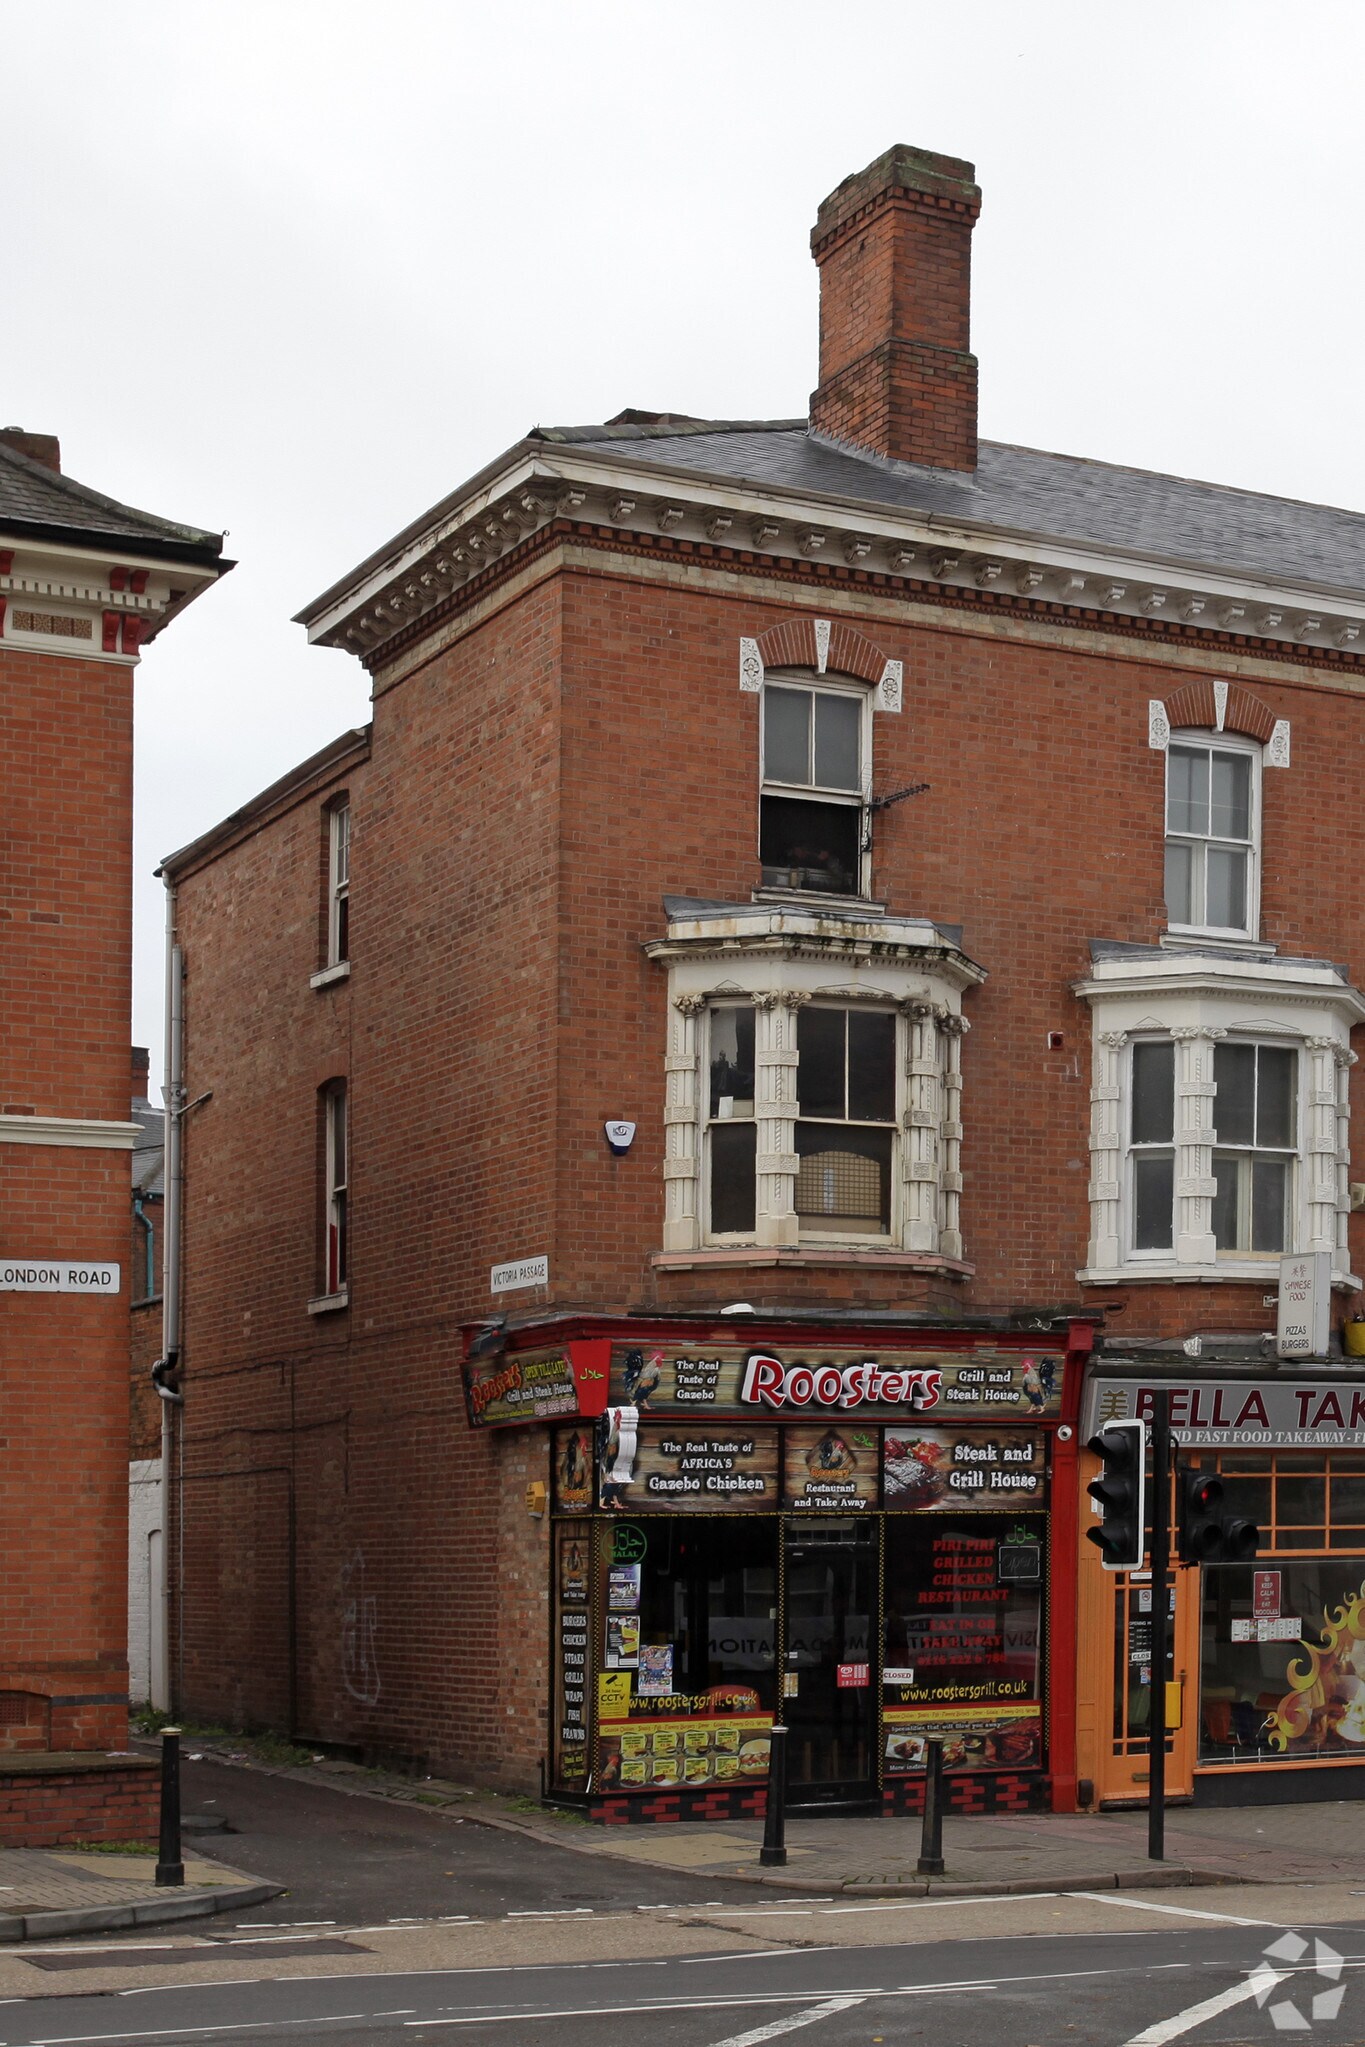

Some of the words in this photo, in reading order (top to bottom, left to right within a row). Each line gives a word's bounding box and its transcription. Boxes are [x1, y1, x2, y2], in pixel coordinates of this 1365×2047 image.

[68, 1270, 112, 1285] ROAD
[493, 1269, 518, 1285] VICTORIA
[520, 1263, 545, 1280] PASSAGE
[1284, 1280, 1311, 1290] CHINESE
[1289, 1292, 1306, 1301] FOOD
[1285, 1325, 1307, 1336] PIZZAS
[1281, 1339, 1310, 1350] BURGERS
[676, 1361, 694, 1370] The
[698, 1361, 719, 1370] Real
[677, 1375, 703, 1384] Taste
[707, 1375, 717, 1384] of
[958, 1370, 985, 1382] Grill
[989, 1370, 1011, 1382] and
[741, 1355, 943, 1410] Roosters
[507, 1389, 521, 1402] Grill
[521, 1386, 533, 1399] and
[535, 1384, 552, 1397] Steak
[553, 1383, 573, 1394] House
[676, 1389, 715, 1400] Gazebo
[946, 1388, 979, 1401] Steak
[984, 1389, 1020, 1401] House
[1134, 1387, 1271, 1428] BELLA
[1195, 1430, 1231, 1443] FAST
[1233, 1430, 1272, 1443] FOOD
[662, 1442, 682, 1452] The
[686, 1442, 708, 1452] Real
[711, 1442, 738, 1452] Taste
[742, 1442, 752, 1452] of
[954, 1444, 997, 1461] Steak
[1003, 1444, 1033, 1461] and
[681, 1458, 732, 1469] AFRICA'S
[649, 1476, 700, 1490] Gazebo
[706, 1475, 764, 1491] Chicken
[949, 1470, 984, 1488] Grill
[990, 1471, 1037, 1488] House
[805, 1483, 856, 1493] Restaurant
[794, 1498, 812, 1507] and
[815, 1498, 838, 1507] Take
[841, 1498, 867, 1509] Away
[608, 1529, 643, 1551] حلال
[1006, 1524, 1037, 1544] حلال
[932, 1540, 962, 1552] PIRI
[965, 1539, 996, 1550] PIRI
[933, 1556, 993, 1568] GRILLED
[932, 1573, 994, 1586] CHICKEN
[917, 1589, 1009, 1604] RESTAURANT
[562, 1615, 586, 1627] BURGERS
[929, 1619, 957, 1631] EAT
[959, 1619, 974, 1630] IN
[562, 1634, 586, 1646] CHICKEN
[923, 1637, 959, 1649] TAKE
[962, 1635, 1002, 1647] AWAY
[564, 1652, 584, 1665] STEAKS
[1132, 1652, 1150, 1660] CLOS
[564, 1671, 584, 1683] GRILLS
[565, 1690, 583, 1702] WRAPS
[900, 1680, 1027, 1701] www.roostersgrill.co.uk
[600, 1694, 626, 1702] CCTV
[629, 1690, 758, 1711] ww.roostersgrill.co.uk
[567, 1709, 580, 1721] FISH
[562, 1728, 585, 1740] PRAWNS
